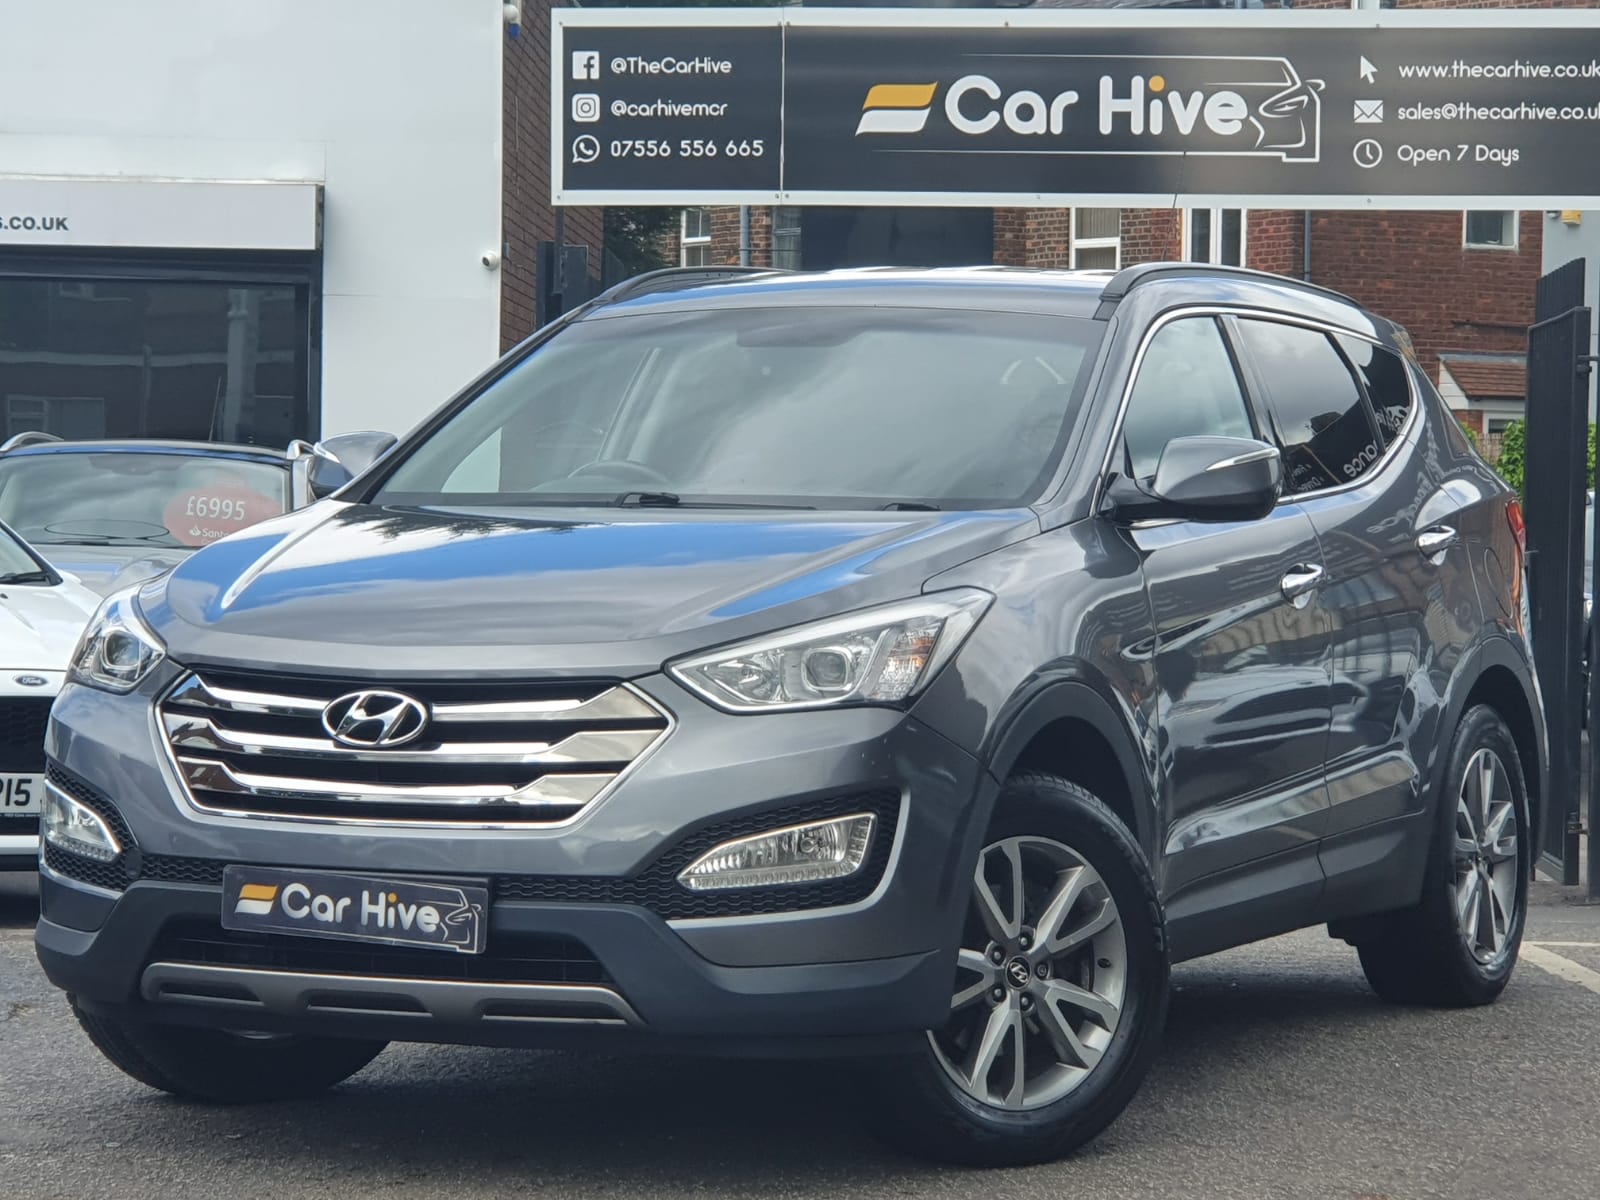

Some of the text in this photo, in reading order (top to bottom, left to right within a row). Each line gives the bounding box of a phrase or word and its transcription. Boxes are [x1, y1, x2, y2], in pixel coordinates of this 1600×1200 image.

[610, 56, 732, 74] @TheCarHive
[1398, 59, 1600, 79] www.thecarhive.co.uk
[610, 98, 728, 117] @carhivemcr
[944, 74, 1248, 136] Car Hive
[1397, 101, 1600, 121] sales@thecarhive.co.u
[610, 139, 764, 157] 07556 556 665
[1397, 144, 1520, 167] Open 7 Days
[0, 216, 69, 231] .CO.UK
[185, 495, 246, 521] £6995
[281, 882, 441, 933] Car Hive
